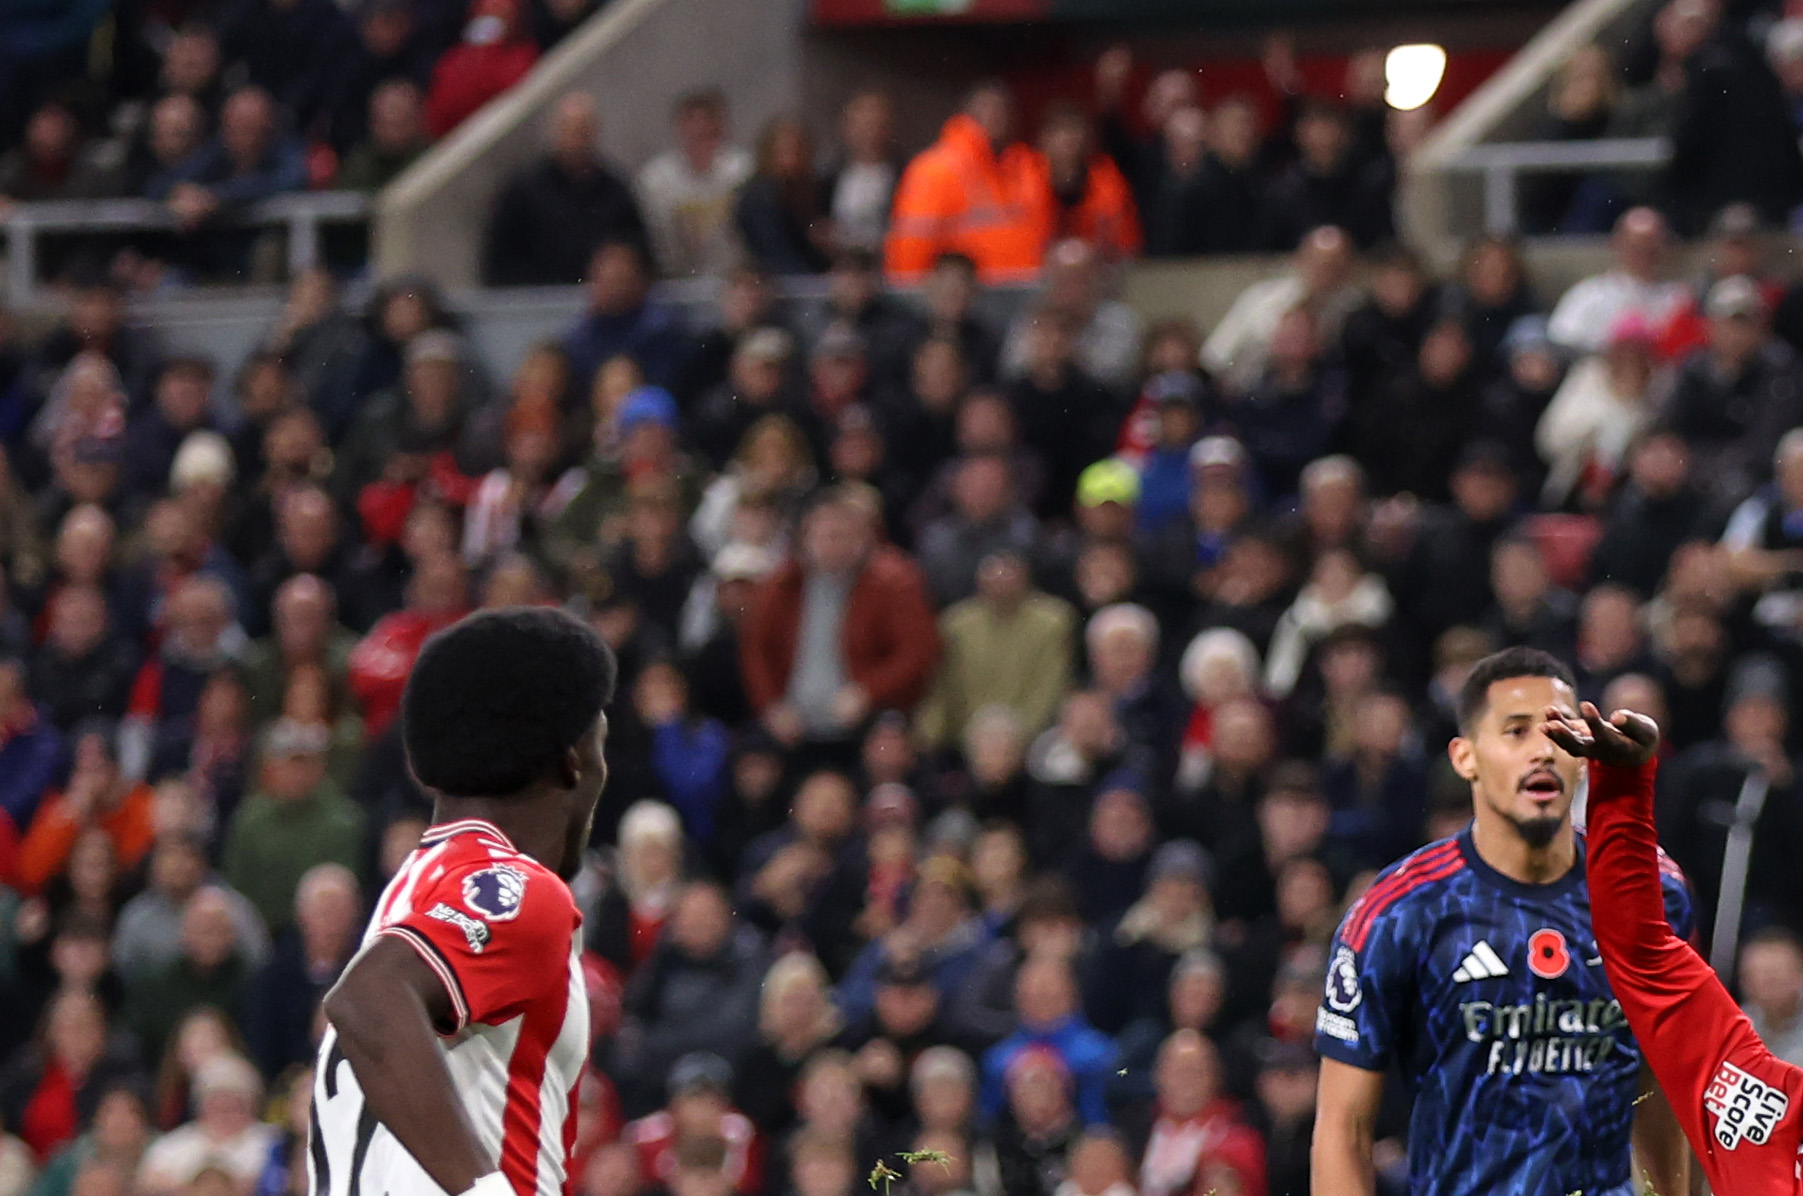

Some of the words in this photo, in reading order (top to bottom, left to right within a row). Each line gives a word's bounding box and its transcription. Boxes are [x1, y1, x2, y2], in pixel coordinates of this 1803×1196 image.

[1459, 991, 1632, 1043] Emirate
[1704, 1066, 1741, 1110] Bet
[1719, 1078, 1763, 1147] Score
[1746, 1091, 1786, 1142] Live
